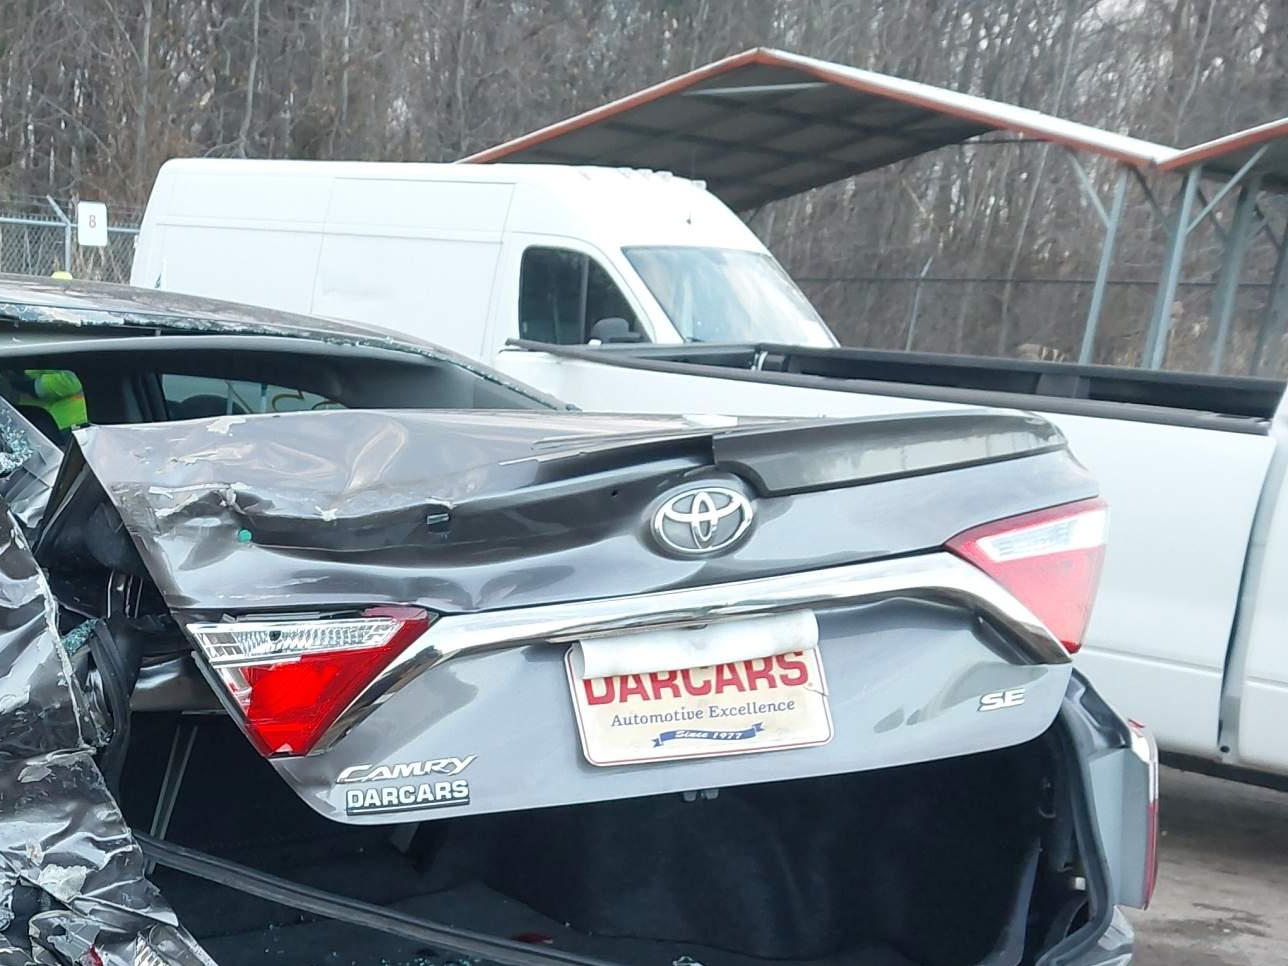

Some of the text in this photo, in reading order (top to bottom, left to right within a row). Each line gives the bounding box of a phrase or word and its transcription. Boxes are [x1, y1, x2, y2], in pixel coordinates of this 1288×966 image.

[88, 214, 97, 229] 8
[583, 651, 808, 706] DARCARS
[611, 698, 795, 727] Automotive Excellence
[977, 688, 1026, 712] SE
[674, 729, 743, 740] Since 1977
[336, 753, 479, 784] CAMRY
[346, 779, 470, 809] DARCARS
